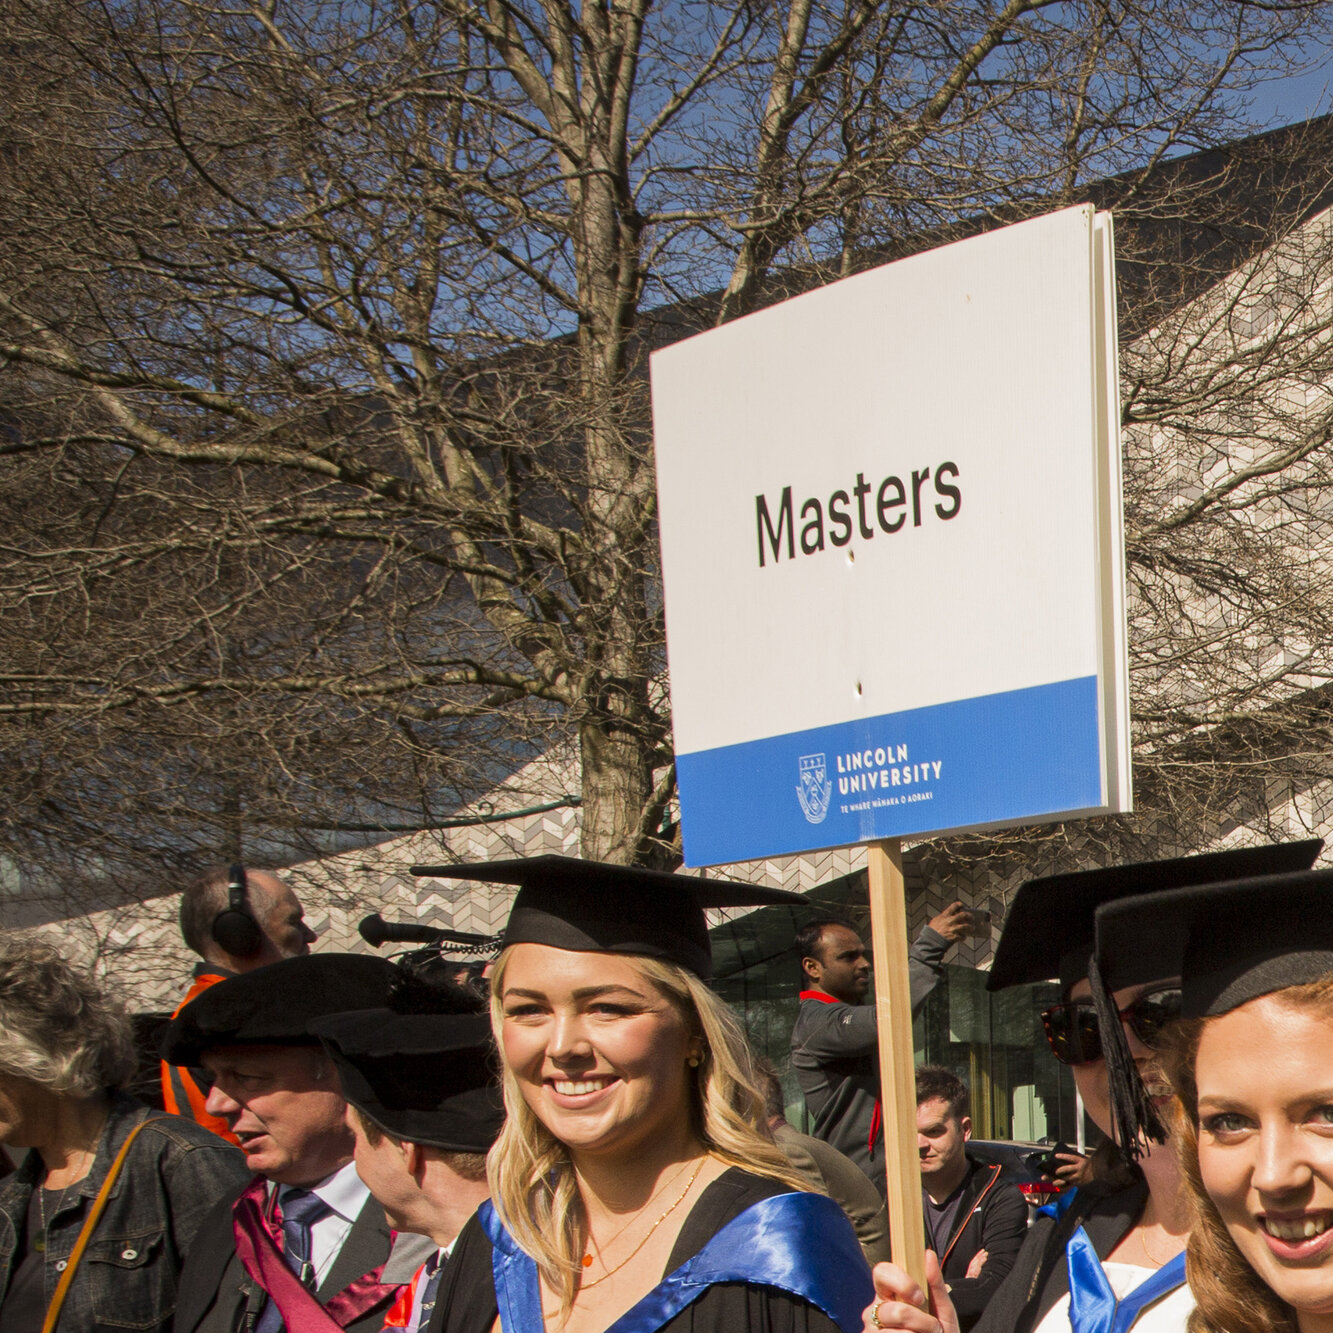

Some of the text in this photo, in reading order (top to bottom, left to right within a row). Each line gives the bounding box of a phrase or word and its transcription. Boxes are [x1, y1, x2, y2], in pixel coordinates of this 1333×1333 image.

[755, 460, 962, 568] Masters
[837, 743, 908, 773] LINCOLN
[838, 760, 942, 795] UNIVERSITY
[840, 805, 849, 814] TE
[850, 800, 871, 812] WHARE
[901, 796, 906, 804] O
[907, 791, 933, 803] AORAKI
